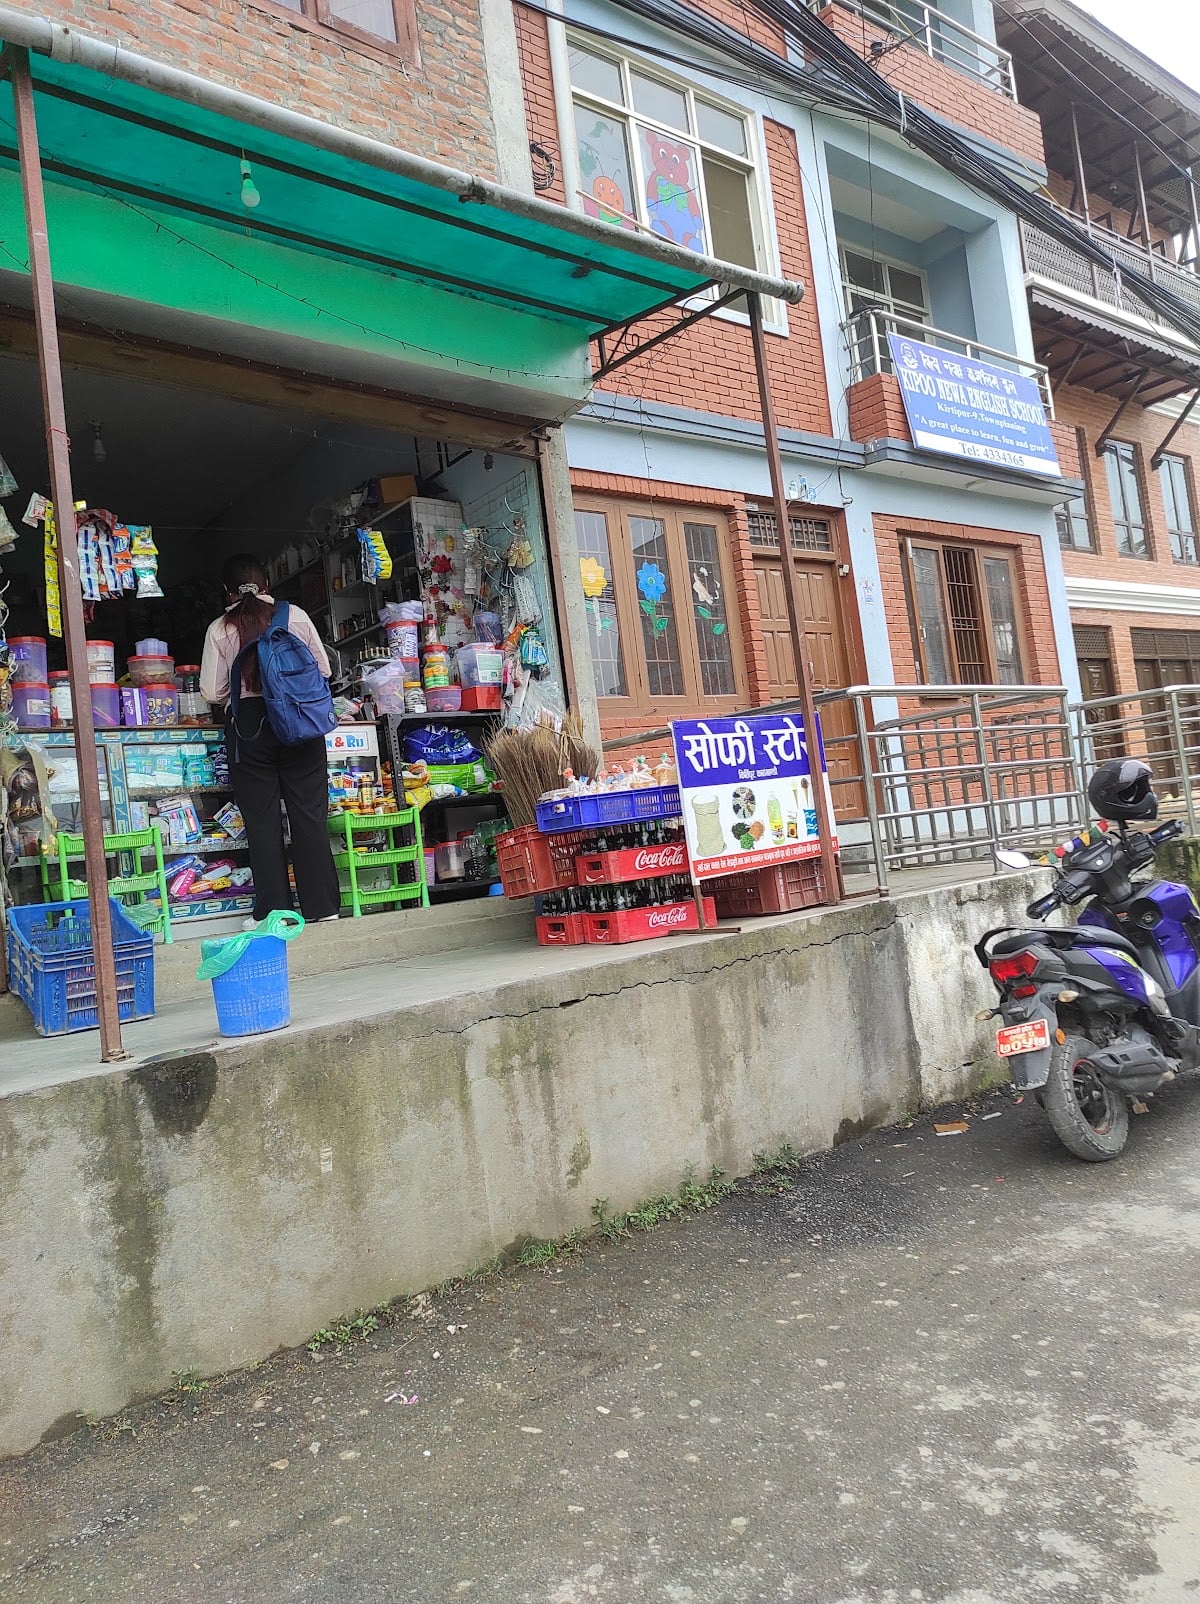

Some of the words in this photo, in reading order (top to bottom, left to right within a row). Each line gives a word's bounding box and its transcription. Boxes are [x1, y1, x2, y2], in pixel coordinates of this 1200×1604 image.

[901, 369, 936, 397] KIPOO
[938, 378, 968, 404] NEWA
[968, 387, 1009, 416] ENGLISH
[1010, 398, 1047, 427] SCHOOL
[928, 419, 949, 429] great
[950, 423, 970, 433] place
[971, 429, 979, 437] to
[1002, 435, 1015, 446] fun
[1015, 440, 1029, 449] and
[960, 442, 980, 456] Tel:
[983, 449, 1024, 466] 4334365
[683, 721, 755, 773] सोफी
[635, 845, 685, 871] Coca-Cola
[648, 905, 688, 928] Coca-Cola
